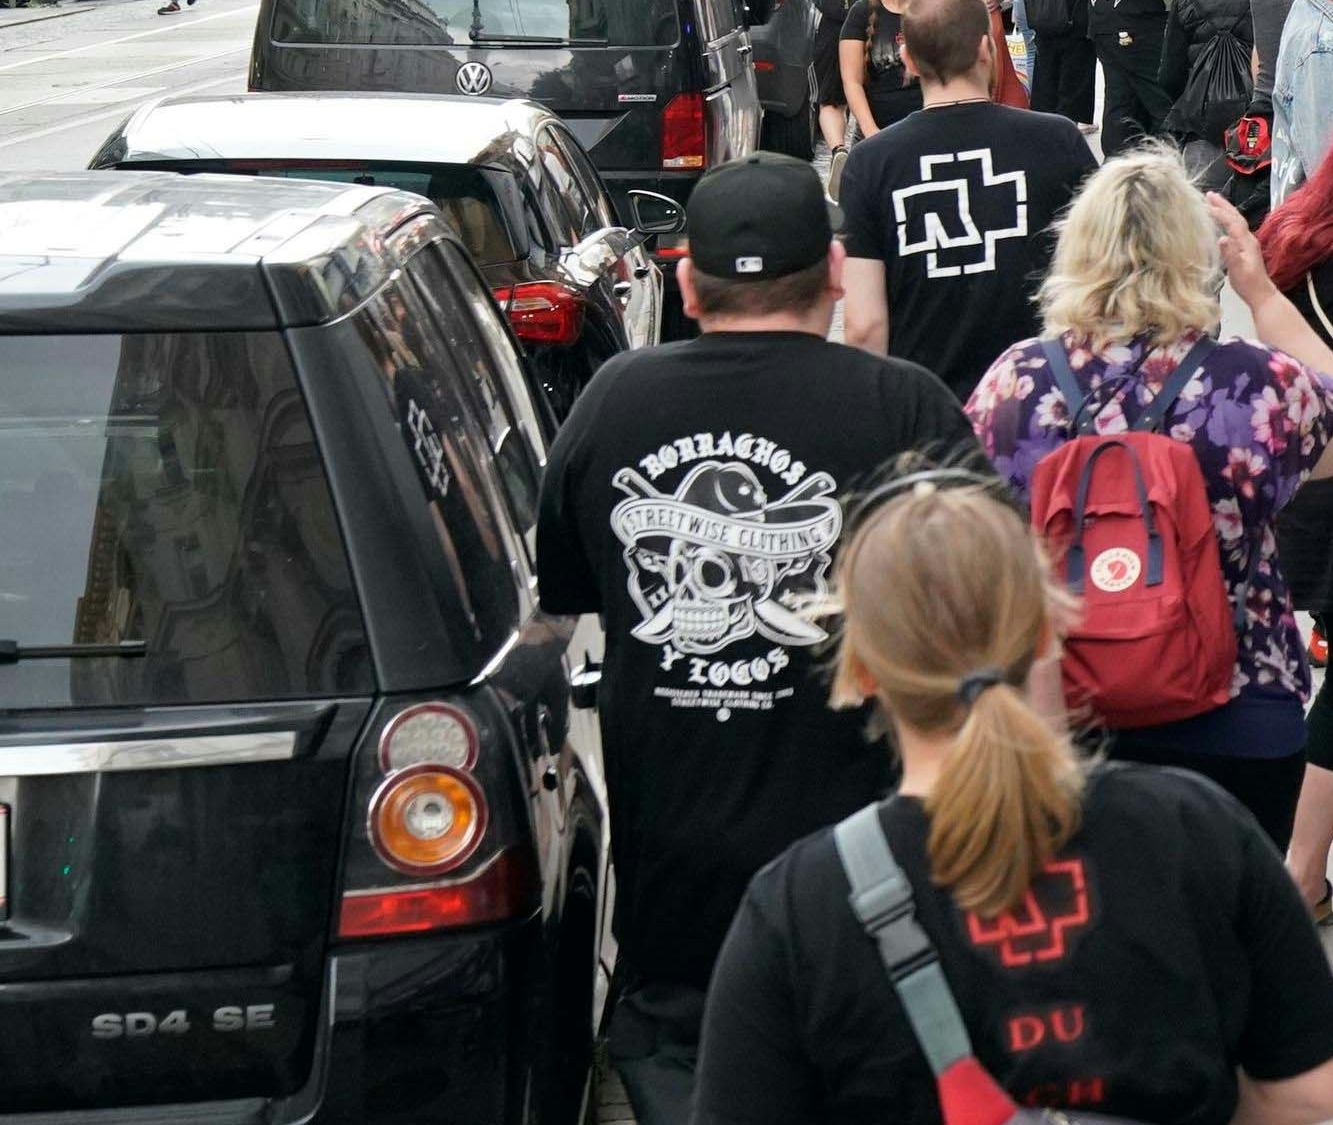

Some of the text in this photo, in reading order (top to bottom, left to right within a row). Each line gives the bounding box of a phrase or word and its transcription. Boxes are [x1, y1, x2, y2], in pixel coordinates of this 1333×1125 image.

[640, 431, 806, 486] BORRACHOS
[738, 526, 822, 553] CLOTHING
[660, 645, 686, 671] Y
[91, 1004, 276, 1038] SD4 SE
[1009, 1006, 1085, 1052] DU
